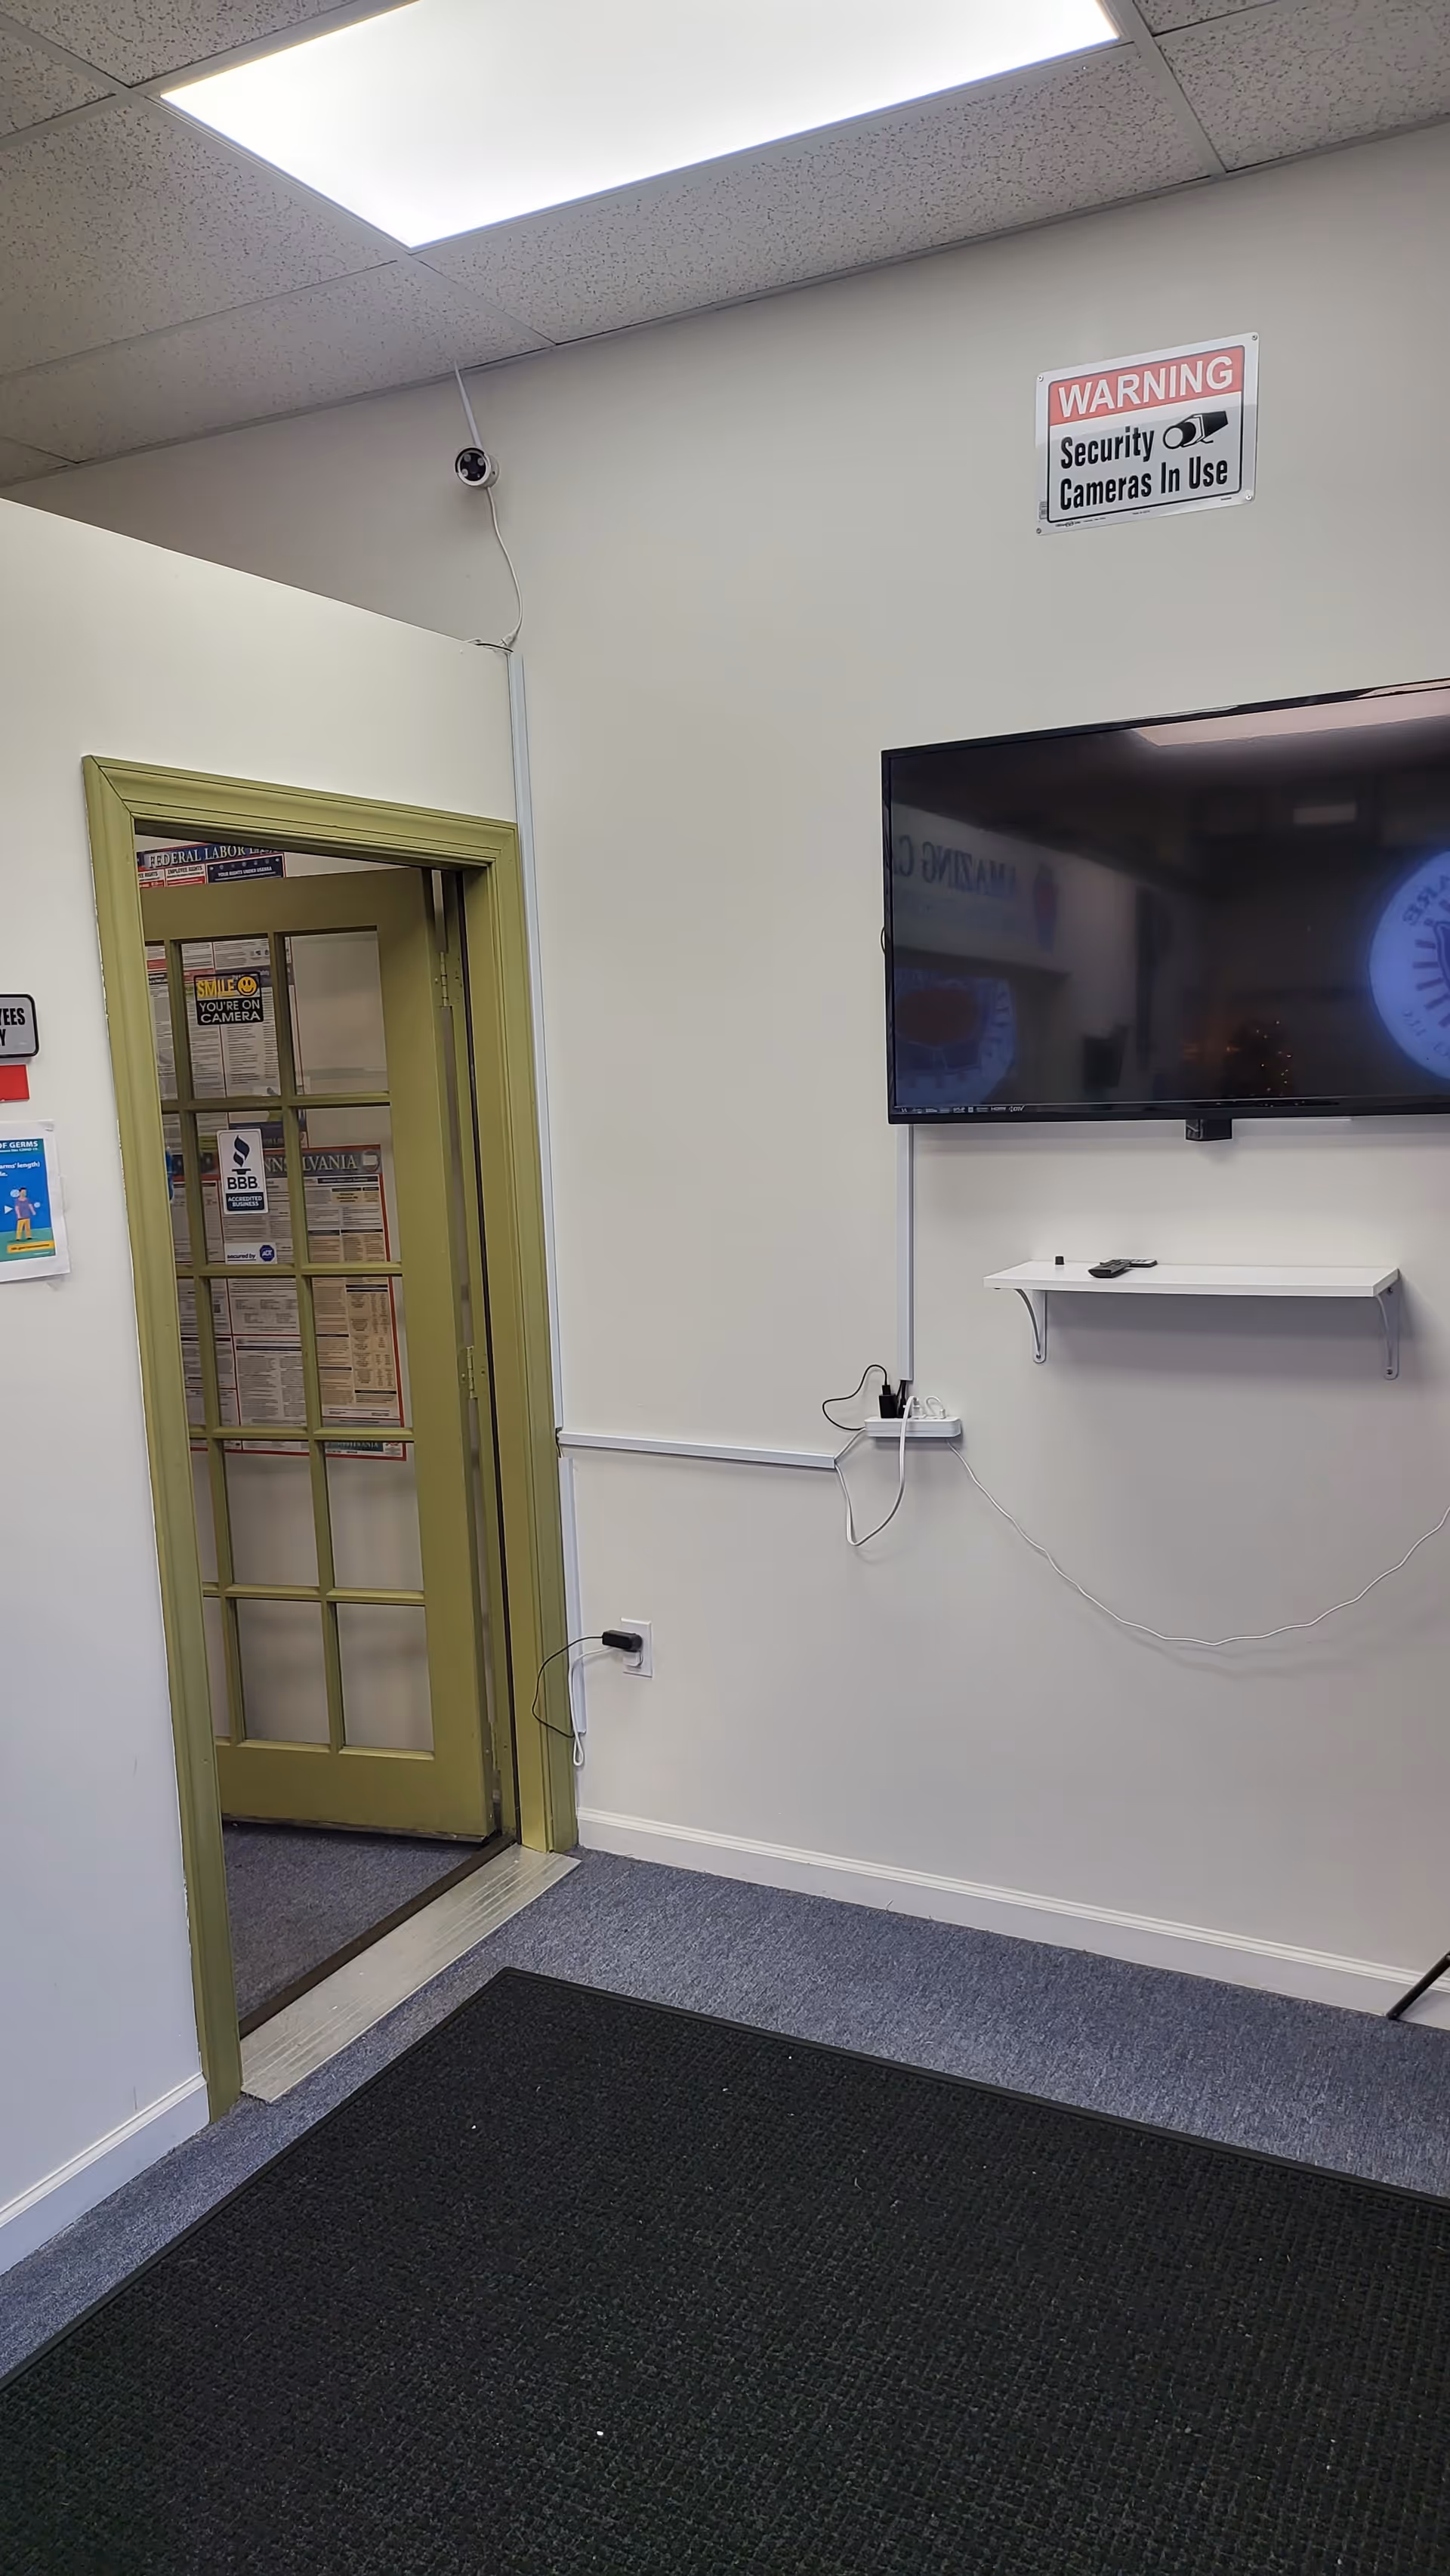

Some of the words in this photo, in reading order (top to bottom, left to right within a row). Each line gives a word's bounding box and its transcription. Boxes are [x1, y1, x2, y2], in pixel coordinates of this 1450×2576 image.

[1058, 356, 1232, 418] WARNING
[1060, 425, 1155, 469] Security
[1060, 472, 1152, 511] Cameras
[1161, 462, 1180, 494] In
[1189, 456, 1228, 490] Use
[148, 849, 202, 868] FEDERAL
[204, 845, 246, 860] LABOR
[197, 978, 234, 998] SMILE
[199, 1000, 239, 1012] YOU'RE
[242, 999, 260, 1010] ON
[0, 1008, 26, 1026] EES
[201, 1011, 261, 1023] CAMERA
[227, 1176, 258, 1190] BBB
